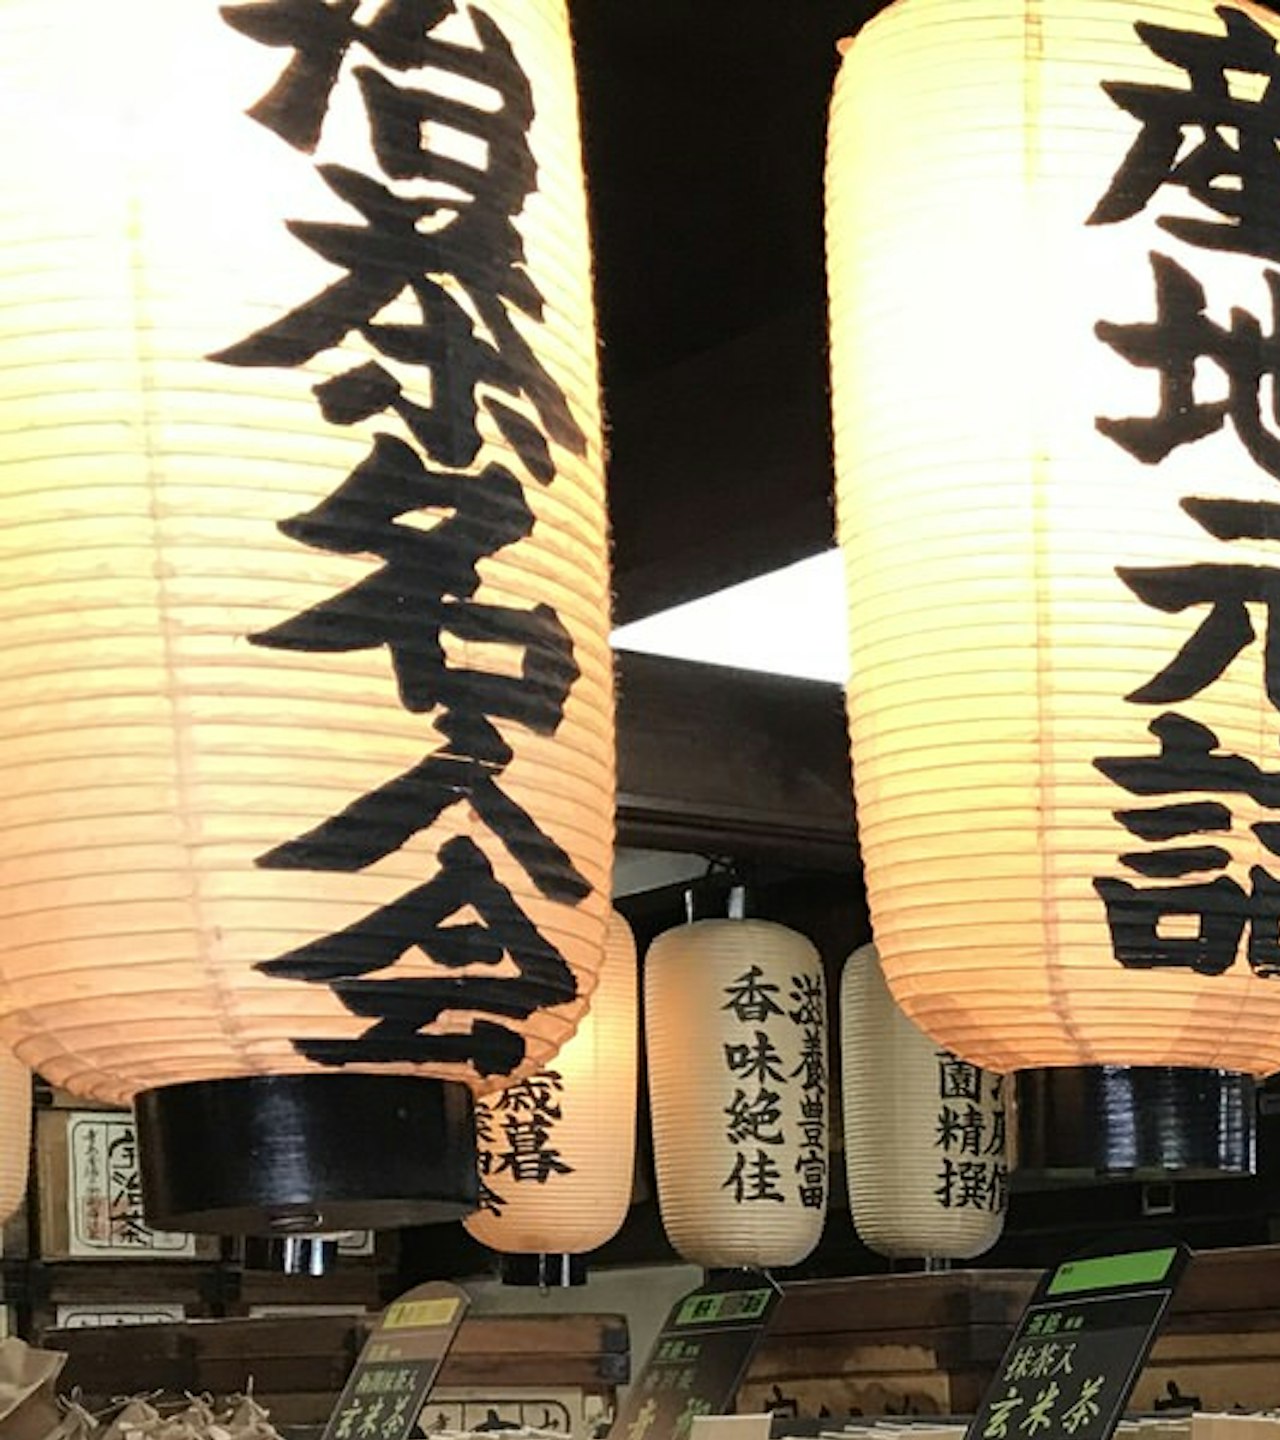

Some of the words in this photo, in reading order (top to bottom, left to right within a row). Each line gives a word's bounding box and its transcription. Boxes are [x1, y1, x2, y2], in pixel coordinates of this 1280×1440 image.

[721, 965, 788, 1204] 香味絶佳
[983, 1375, 1105, 1440] 玄米茶
